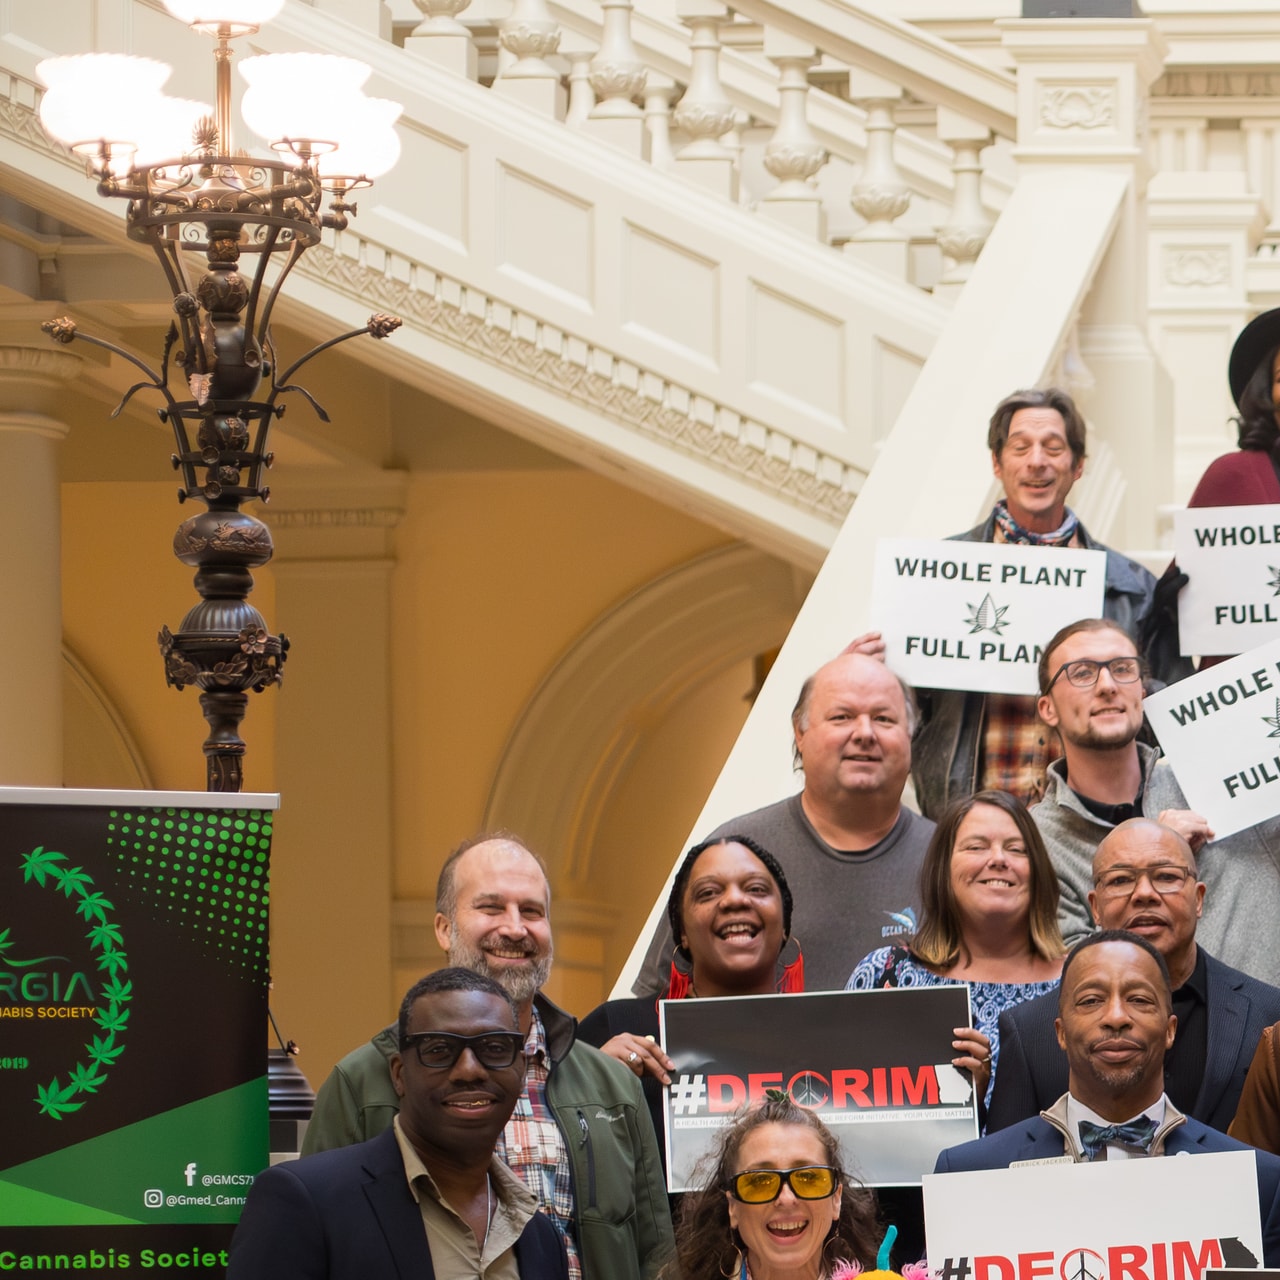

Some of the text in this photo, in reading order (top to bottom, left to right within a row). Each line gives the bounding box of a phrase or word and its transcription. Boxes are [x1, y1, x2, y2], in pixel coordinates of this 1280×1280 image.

[895, 557, 1087, 588] WHOLE PLANT
[1215, 604, 1278, 625] FULL
[905, 636, 970, 660] FULL
[1169, 668, 1273, 727] WHOLE
[37, 1007, 96, 1019] SOCIETY
[0, 1247, 229, 1270] Cannabis Societ
